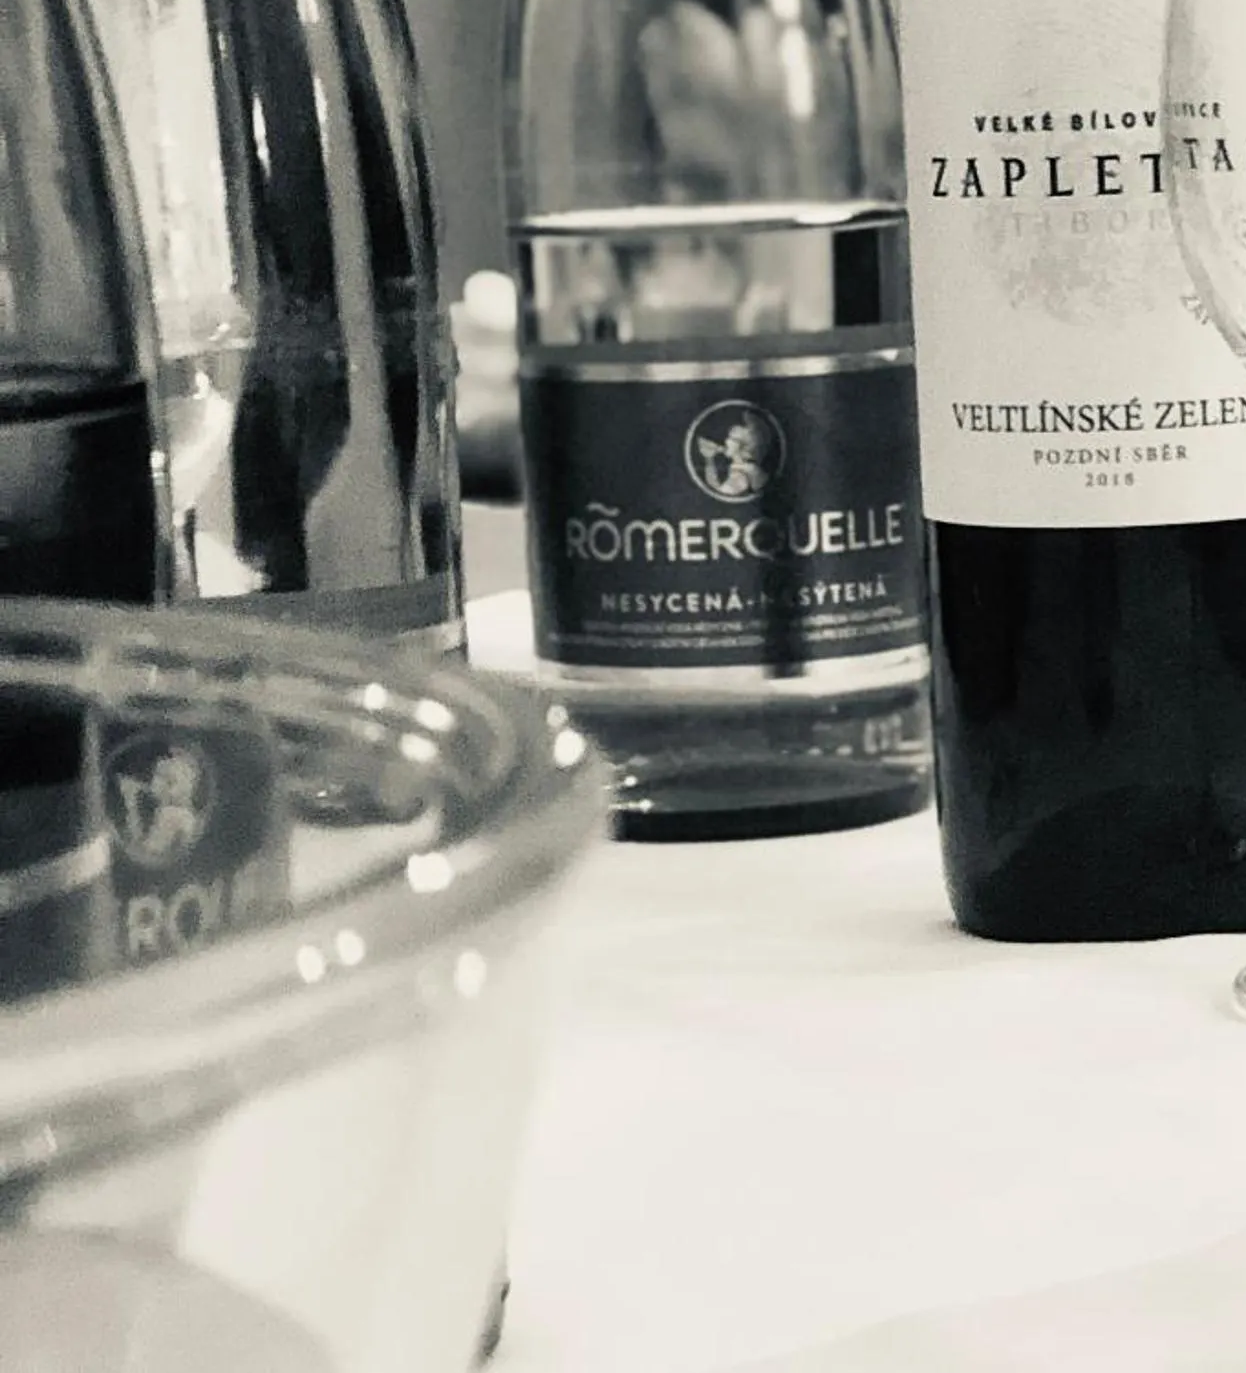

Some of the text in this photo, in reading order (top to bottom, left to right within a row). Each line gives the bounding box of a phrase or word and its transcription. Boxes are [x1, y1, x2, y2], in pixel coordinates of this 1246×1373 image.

[974, 109, 1055, 134] VELKÉ
[952, 397, 1146, 434] VELTLÍNSKÉ
[1033, 446, 1122, 466] POZDNÍ
